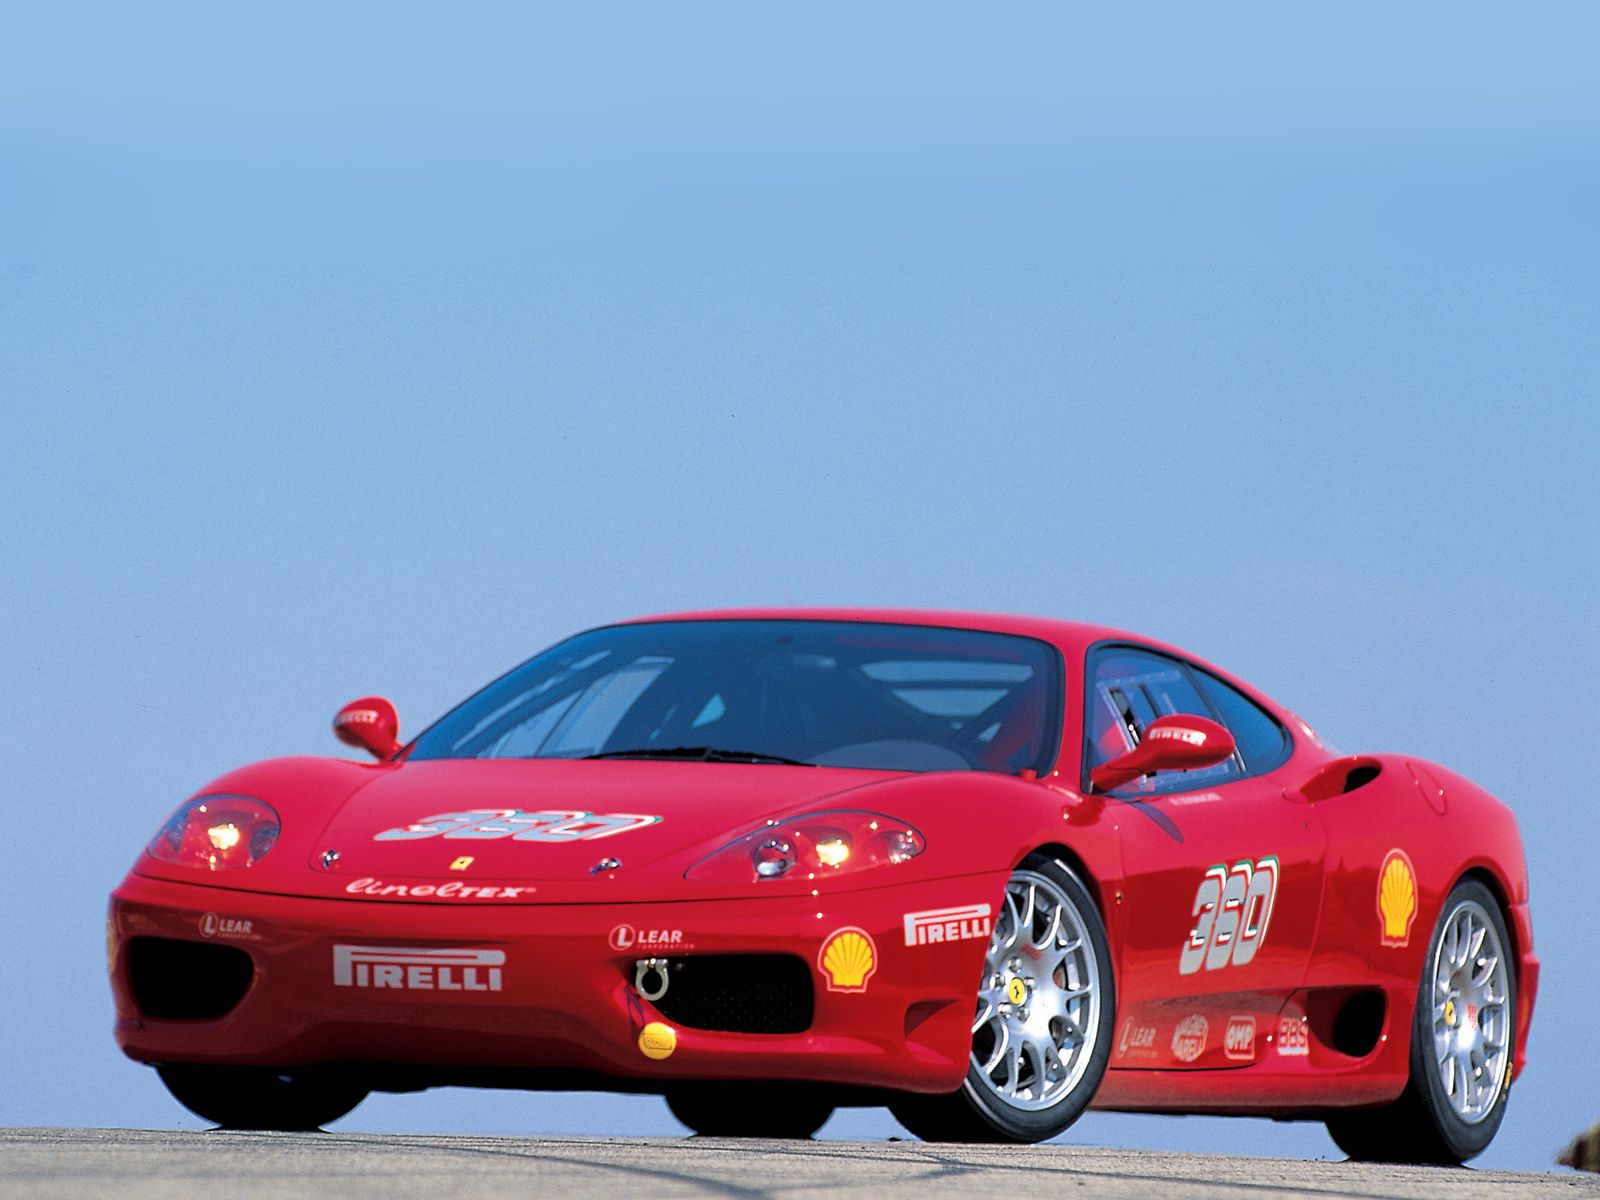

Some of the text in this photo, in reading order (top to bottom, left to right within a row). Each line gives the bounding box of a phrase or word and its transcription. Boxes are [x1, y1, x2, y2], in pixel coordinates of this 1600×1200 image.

[373, 809, 663, 842] 360
[219, 919, 253, 934] LEAR
[904, 903, 991, 946] PIRELLI
[1179, 855, 1279, 976] 360
[638, 930, 682, 943] LEAR
[333, 945, 506, 991] PIRELLI
